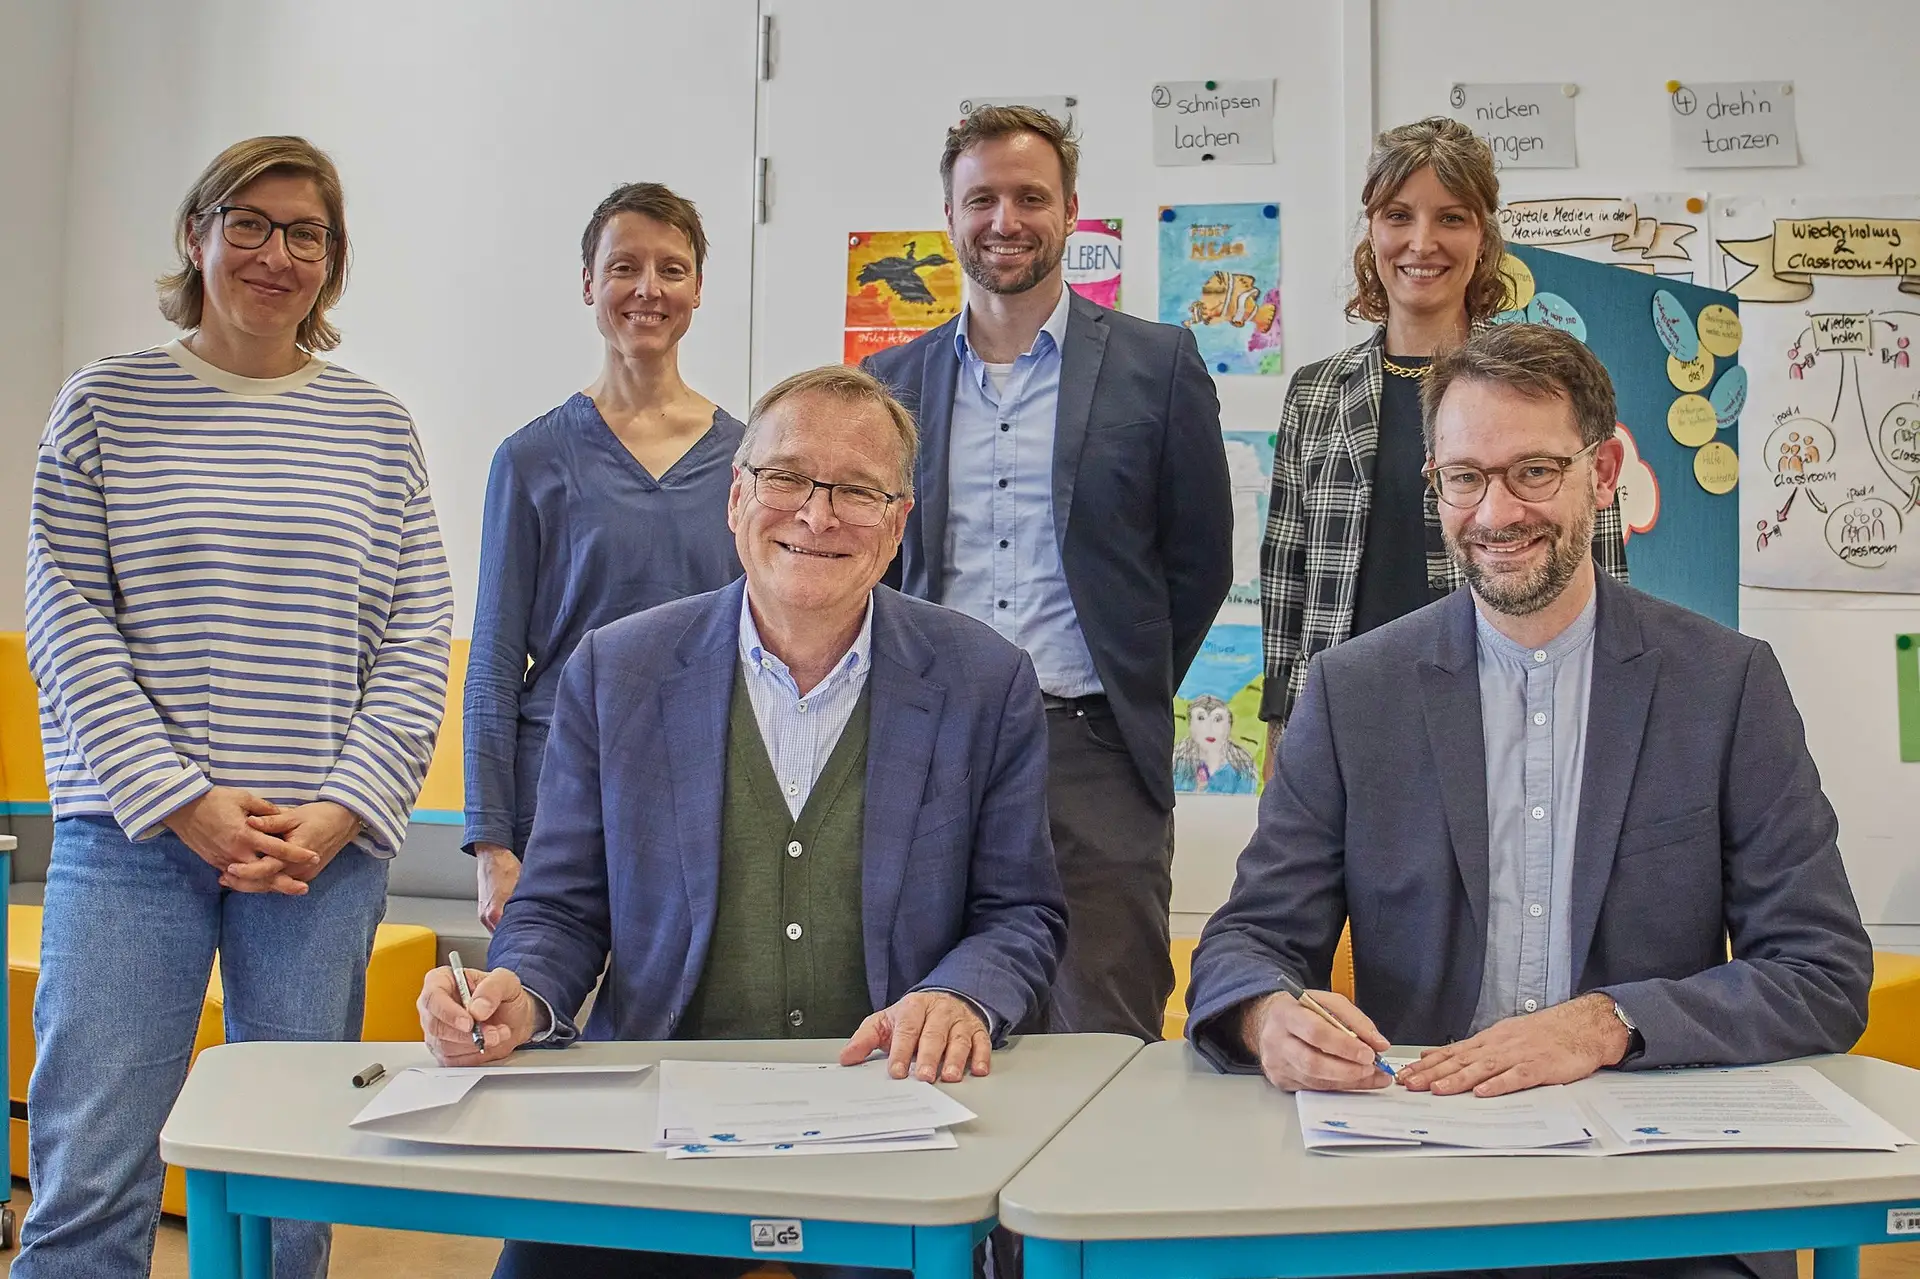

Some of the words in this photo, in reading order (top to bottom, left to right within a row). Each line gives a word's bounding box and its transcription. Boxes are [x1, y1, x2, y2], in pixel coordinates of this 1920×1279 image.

[1476, 96, 1541, 120] nicken
[1706, 89, 1771, 120] dreh'n
[1174, 124, 1240, 149] lachen
[1486, 132, 1544, 161] ingen
[1701, 128, 1780, 154] tanzen
[1501, 207, 1549, 227] Digitale
[1553, 206, 1594, 222] Medien
[1599, 211, 1609, 221] in
[1612, 210, 1633, 221] der
[1511, 225, 1591, 239] Martinschule
[1792, 220, 1901, 246] Wiederholung
[1787, 253, 1917, 276] Classroom-App
[1831, 329, 1863, 345] holen
[1773, 472, 1837, 487] Classroom
[1839, 544, 1898, 560] Classroom
[776, 1225, 800, 1245] GS
